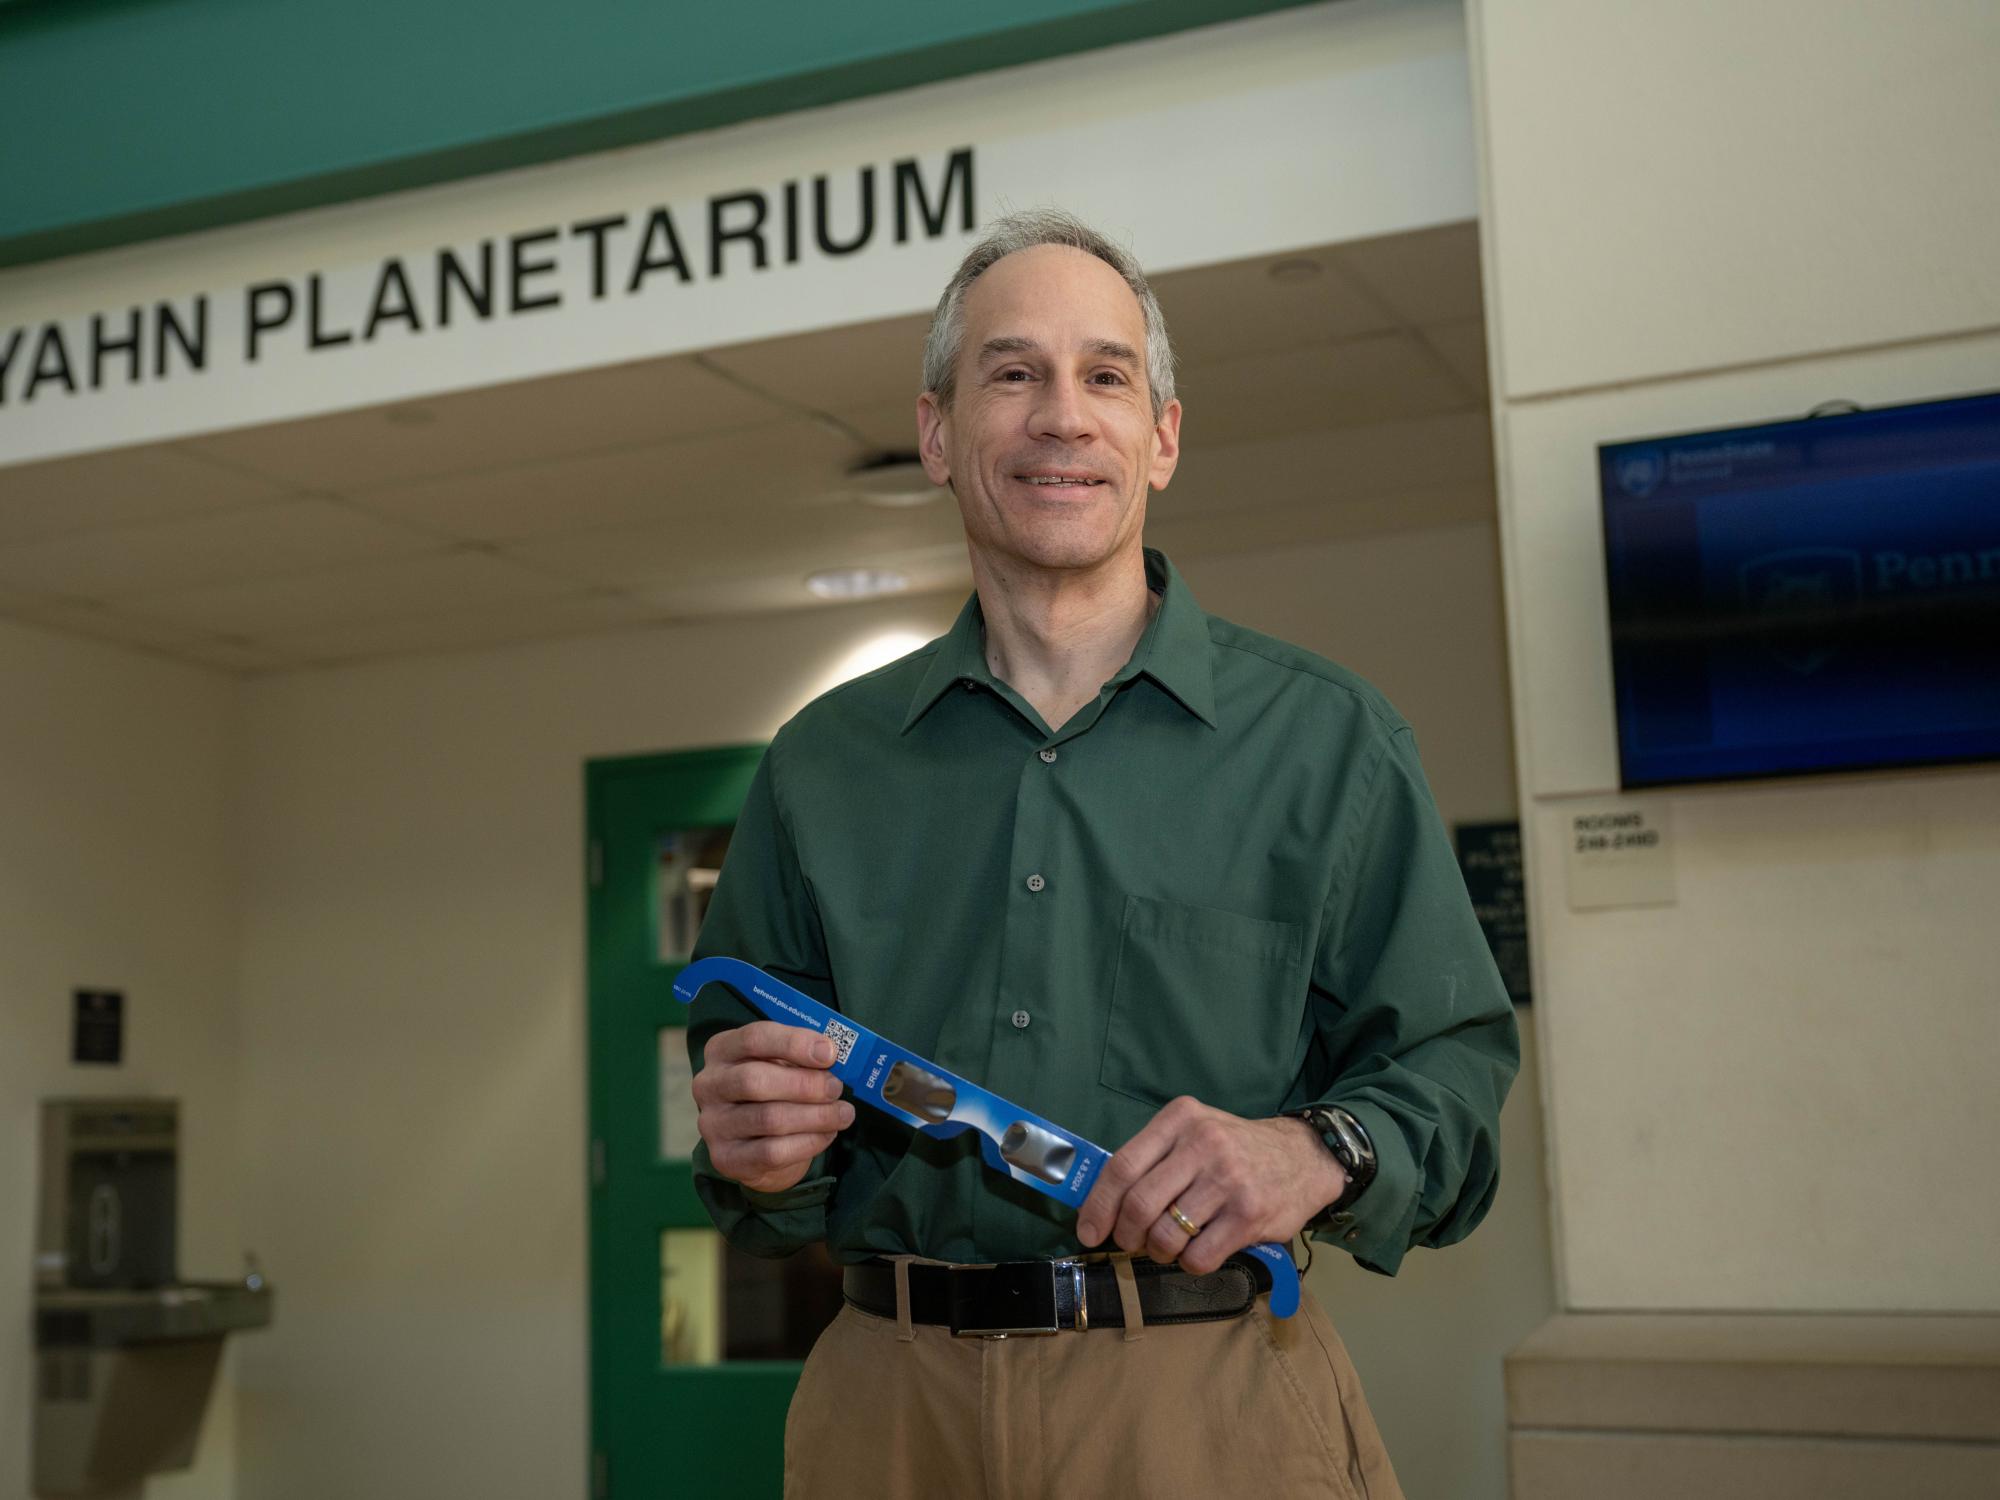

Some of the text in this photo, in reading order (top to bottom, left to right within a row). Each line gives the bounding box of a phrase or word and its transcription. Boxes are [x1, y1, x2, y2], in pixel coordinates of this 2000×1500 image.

[0, 147, 977, 406] YAHN PLANETARIUM
[876, 1054, 888, 1066] PA
